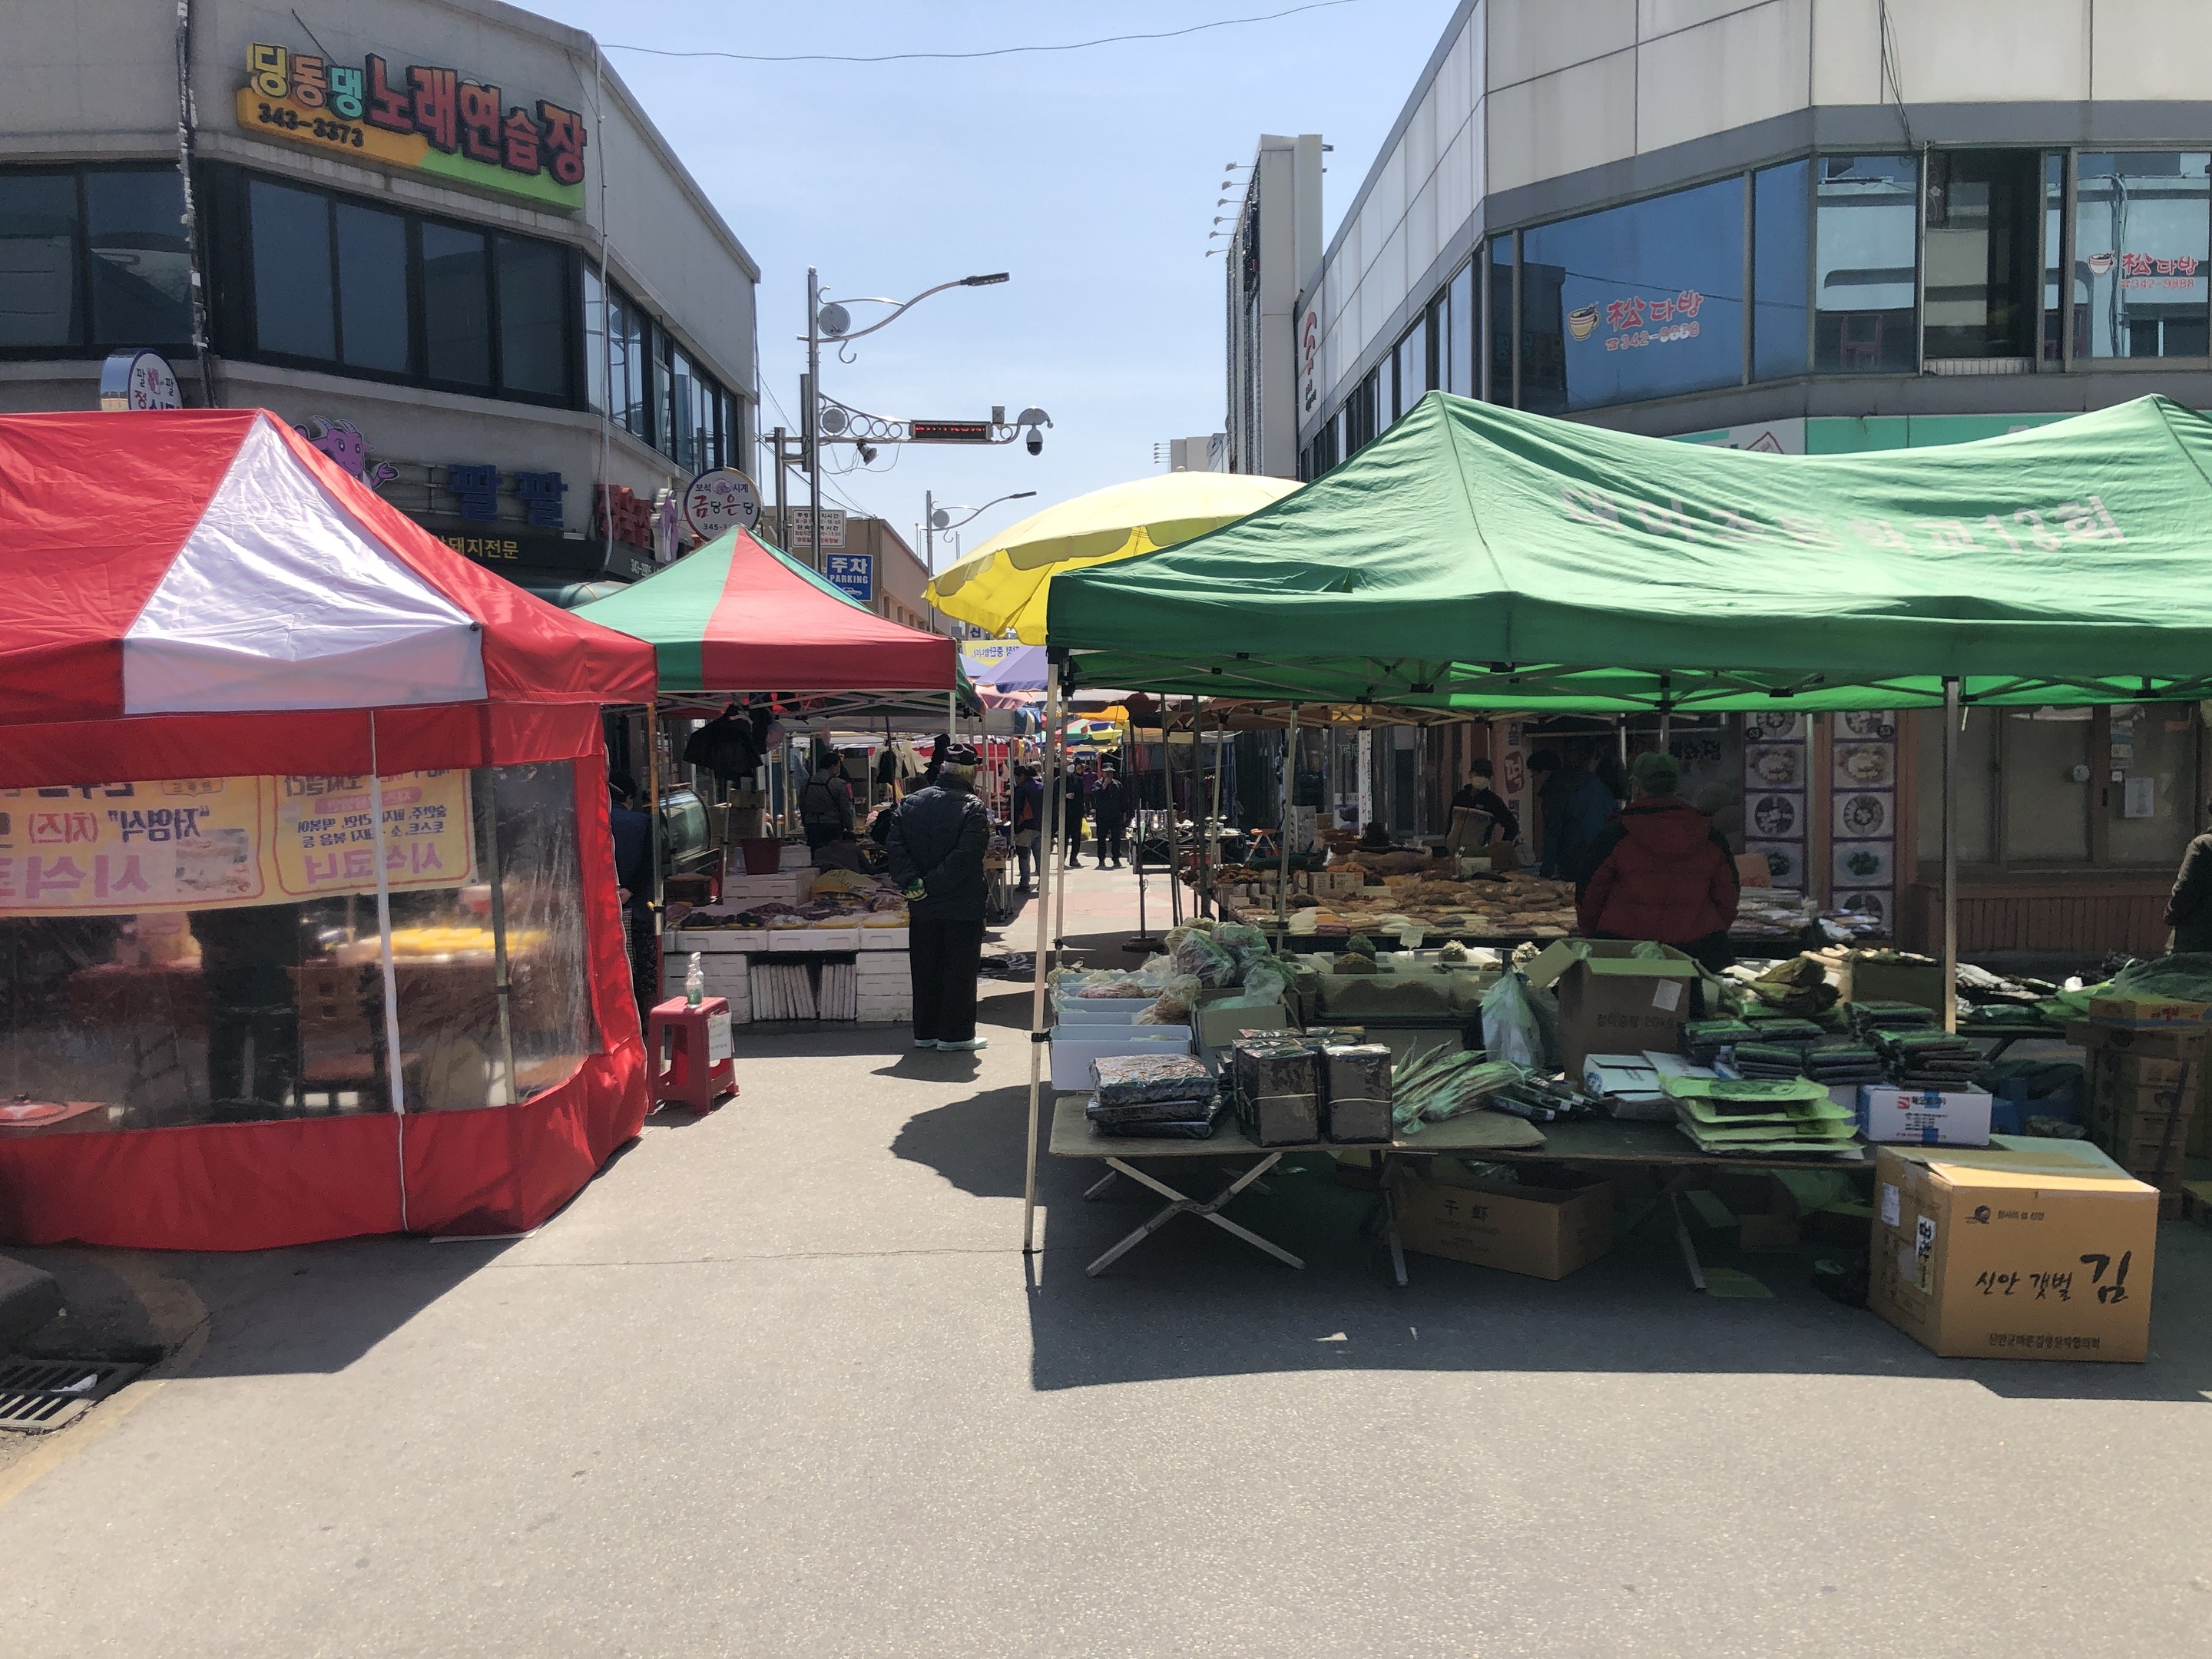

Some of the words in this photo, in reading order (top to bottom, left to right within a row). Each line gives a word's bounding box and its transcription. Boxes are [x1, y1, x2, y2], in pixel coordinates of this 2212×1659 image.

[247, 43, 366, 121] 딩동댕
[366, 53, 587, 186] 노래연습장
[258, 103, 364, 147] 343-3373
[2121, 253, 2198, 275] 松다방
[2132, 279, 2194, 289] 342-9888
[1607, 289, 1704, 331] 松다방
[695, 483, 712, 493] 보석
[732, 483, 749, 494] 시계
[435, 535, 519, 559] 돼지전문
[830, 557, 868, 575] 주차
[830, 575, 869, 584] PARKING
[1975, 1270, 2020, 1296] 신안
[2029, 1270, 2074, 1302] 갯벌
[2080, 1250, 2133, 1304] 김
